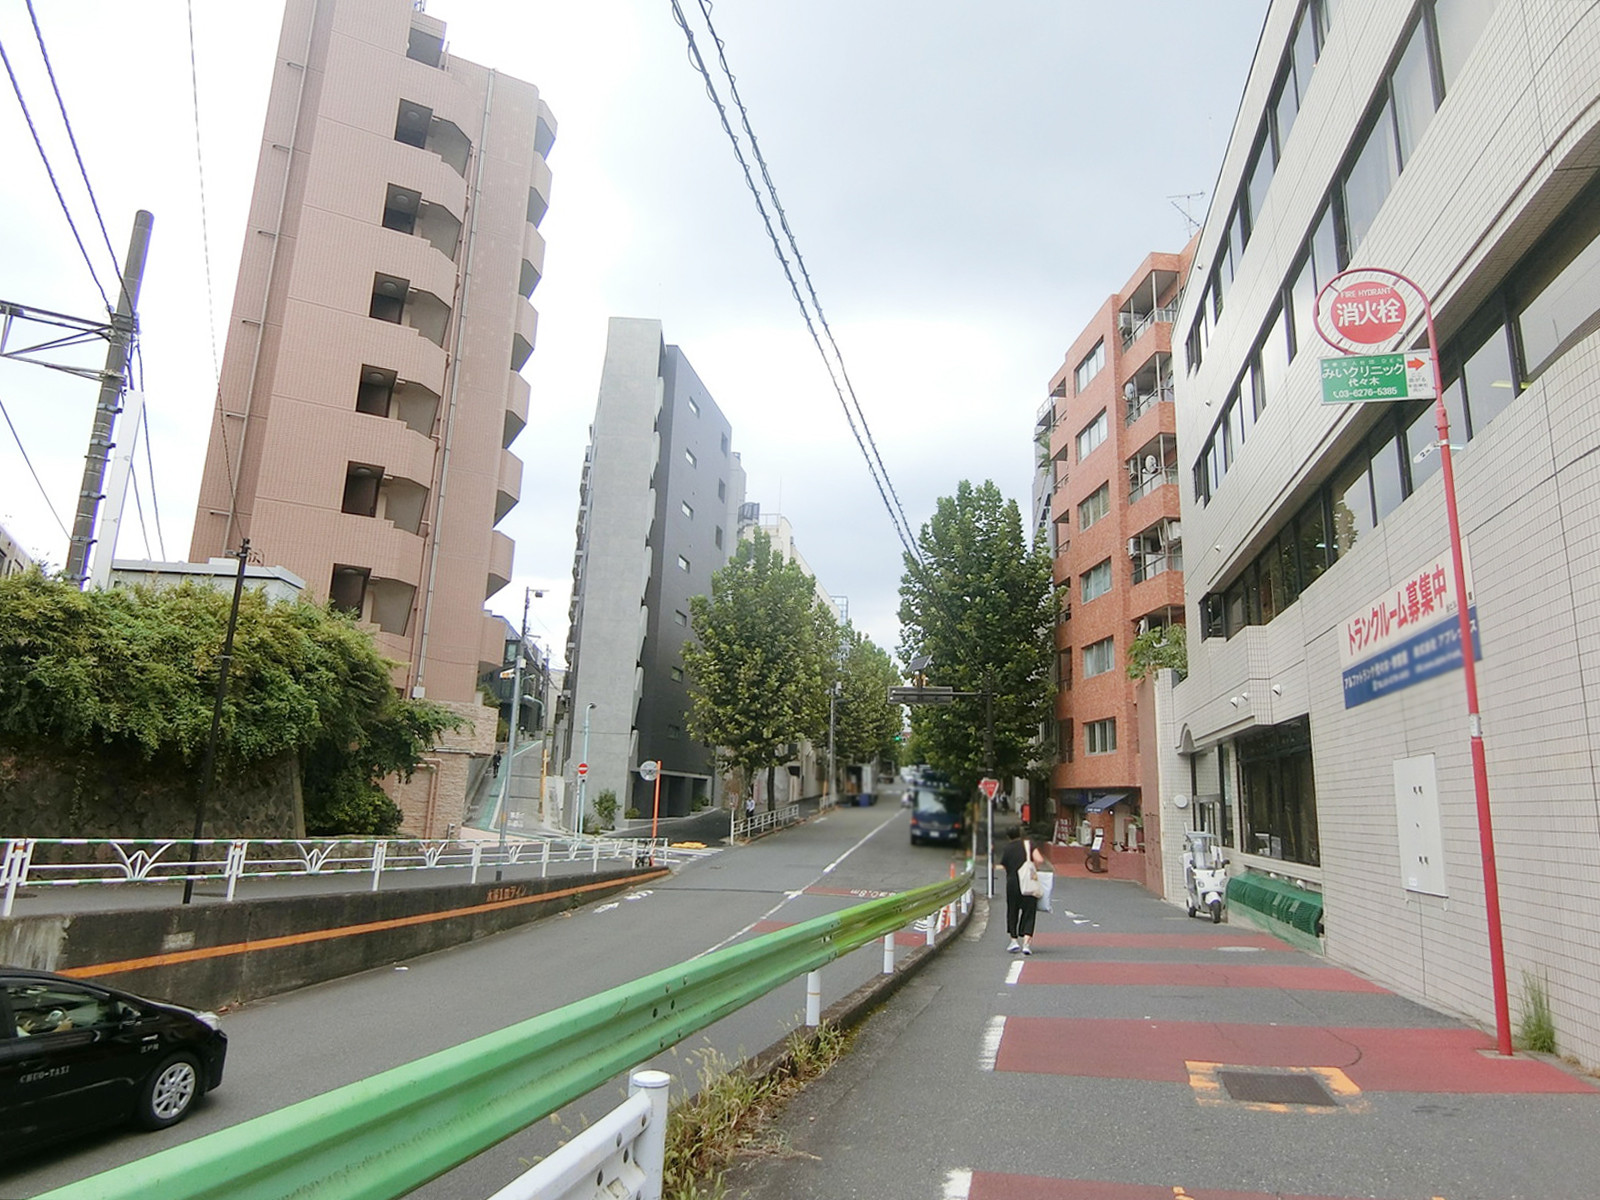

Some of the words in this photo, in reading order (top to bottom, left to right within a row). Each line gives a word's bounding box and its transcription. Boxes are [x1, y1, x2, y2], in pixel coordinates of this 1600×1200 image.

[1340, 289, 1356, 298] FIRE
[1358, 287, 1391, 298] HYDRANT
[1336, 299, 1401, 327] 消火栓
[1322, 363, 1404, 379] みいクリニック
[1348, 377, 1380, 387] 代々木
[1347, 563, 1447, 656] トランクルーム募集中
